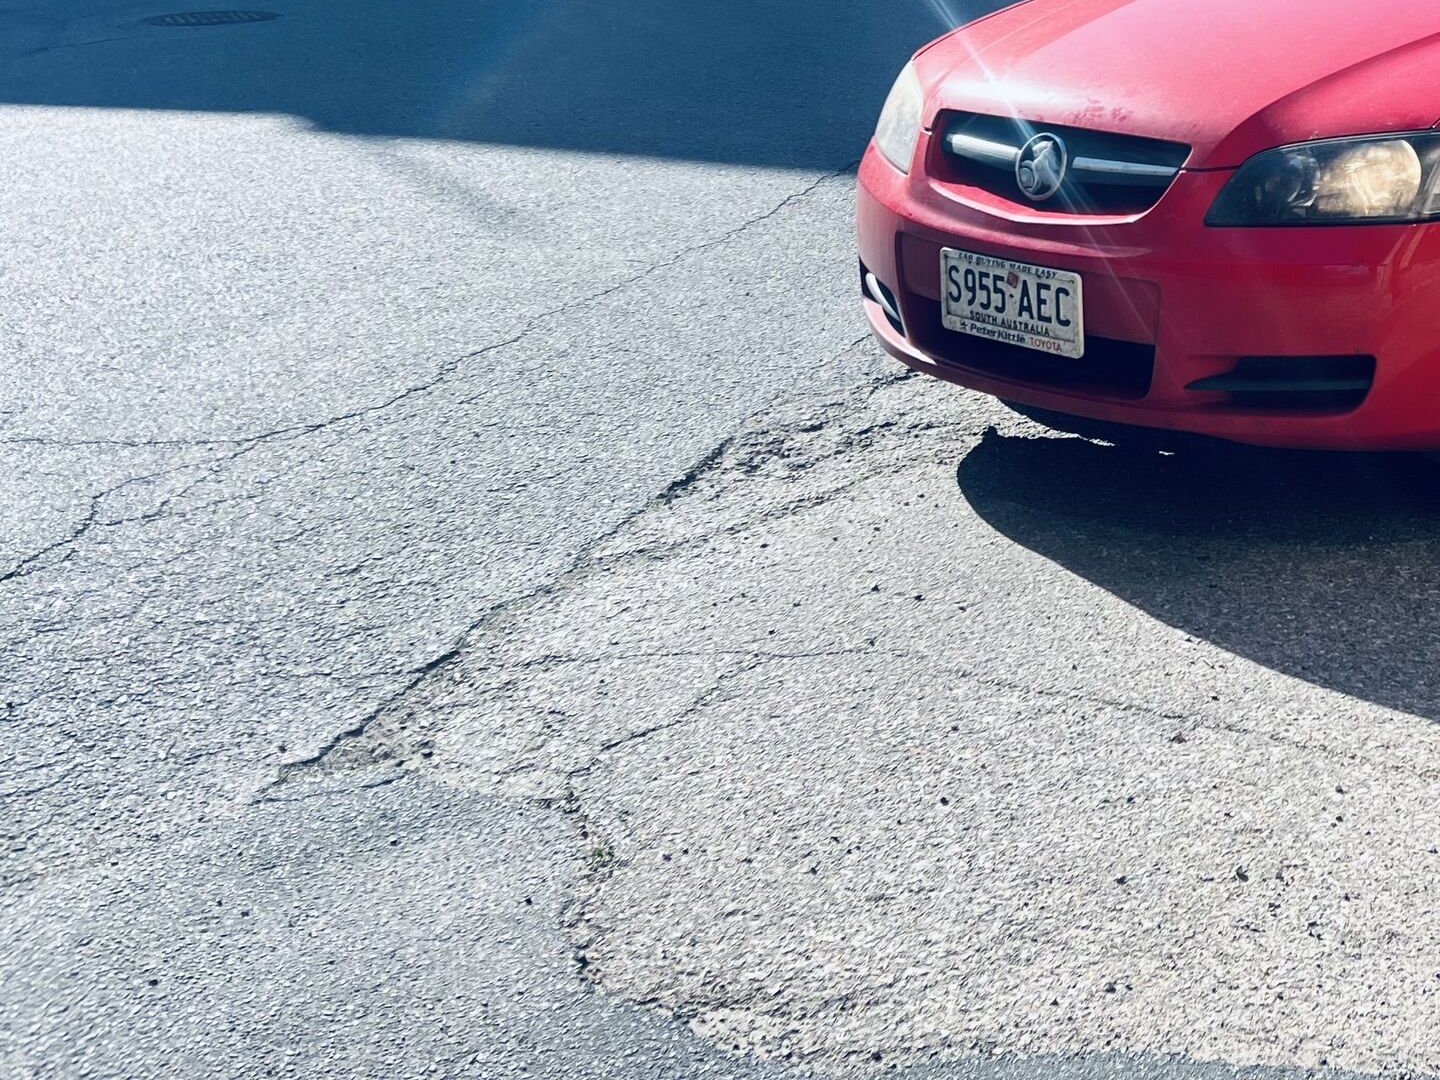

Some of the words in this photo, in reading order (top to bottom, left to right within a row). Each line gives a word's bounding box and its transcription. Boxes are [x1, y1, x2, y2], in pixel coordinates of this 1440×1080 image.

[958, 252, 974, 265] CAR
[976, 256, 1006, 270] BUYING
[1009, 263, 1032, 275] MADE
[1034, 267, 1058, 280] EASY
[969, 310, 998, 325] SOUTH
[1001, 318, 1050, 337] AUSTRALIA
[1029, 336, 1063, 353] TOYOTA
